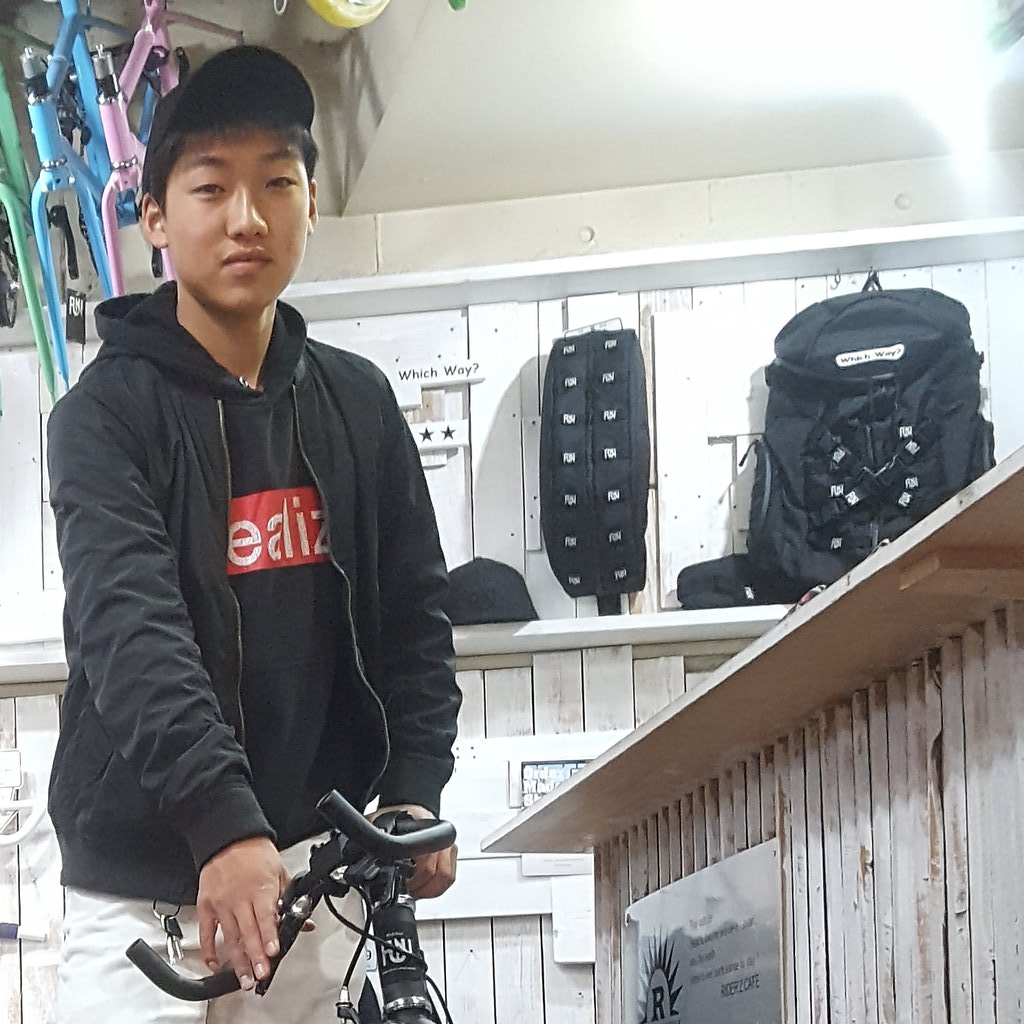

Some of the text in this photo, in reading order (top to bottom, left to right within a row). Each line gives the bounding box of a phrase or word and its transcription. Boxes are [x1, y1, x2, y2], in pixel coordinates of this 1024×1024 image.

[840, 348, 902, 363] Which Way?
[398, 363, 479, 380] Which Way?
[651, 985, 666, 1022] R
